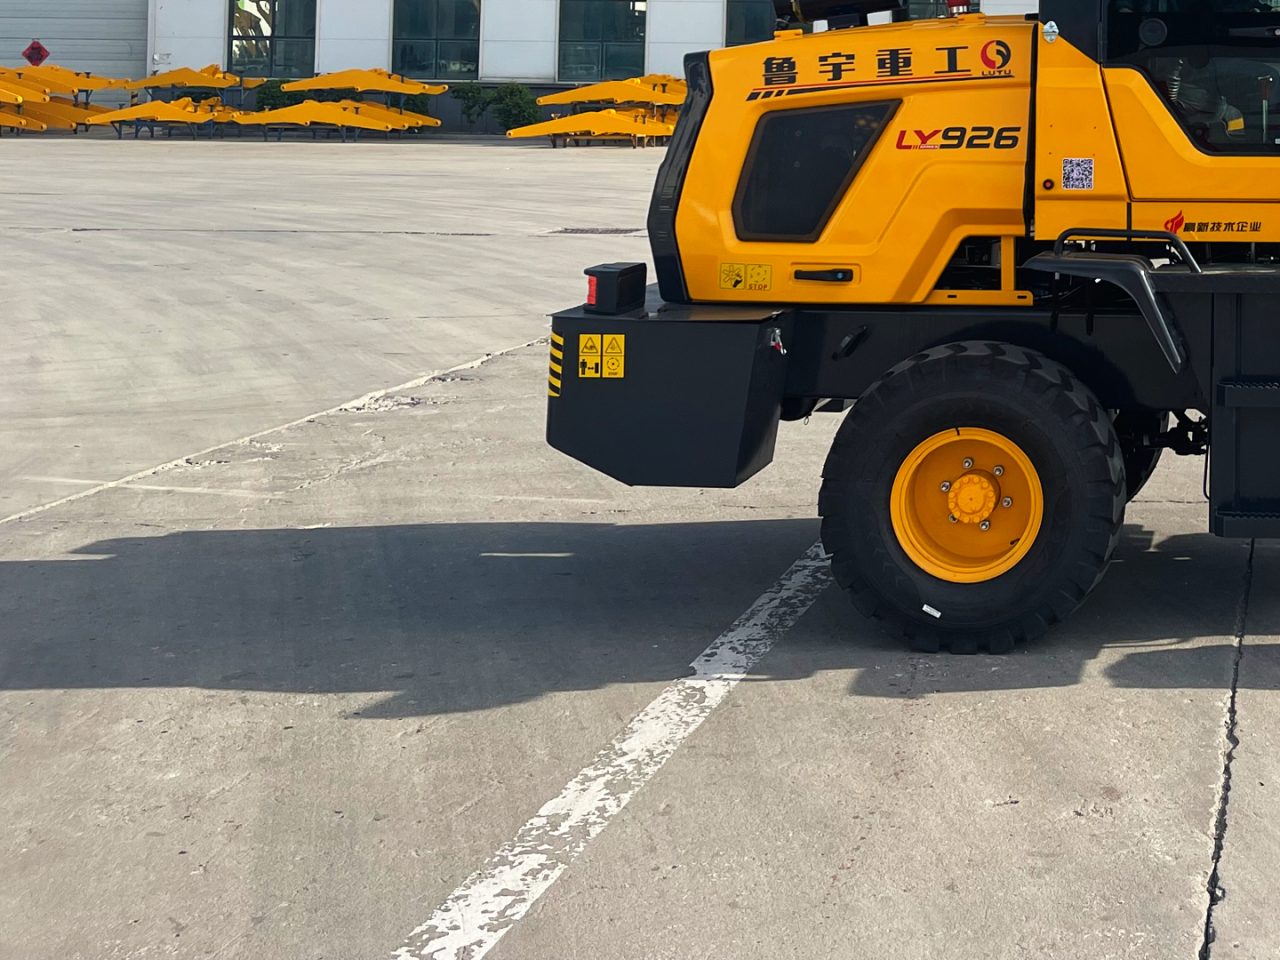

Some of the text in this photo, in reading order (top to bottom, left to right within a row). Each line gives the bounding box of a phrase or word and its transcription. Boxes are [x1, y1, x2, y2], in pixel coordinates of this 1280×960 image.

[762, 45, 971, 86] 鲁宇重工
[896, 126, 1022, 150] LY926
[1182, 221, 1262, 233] 高新技术企业
